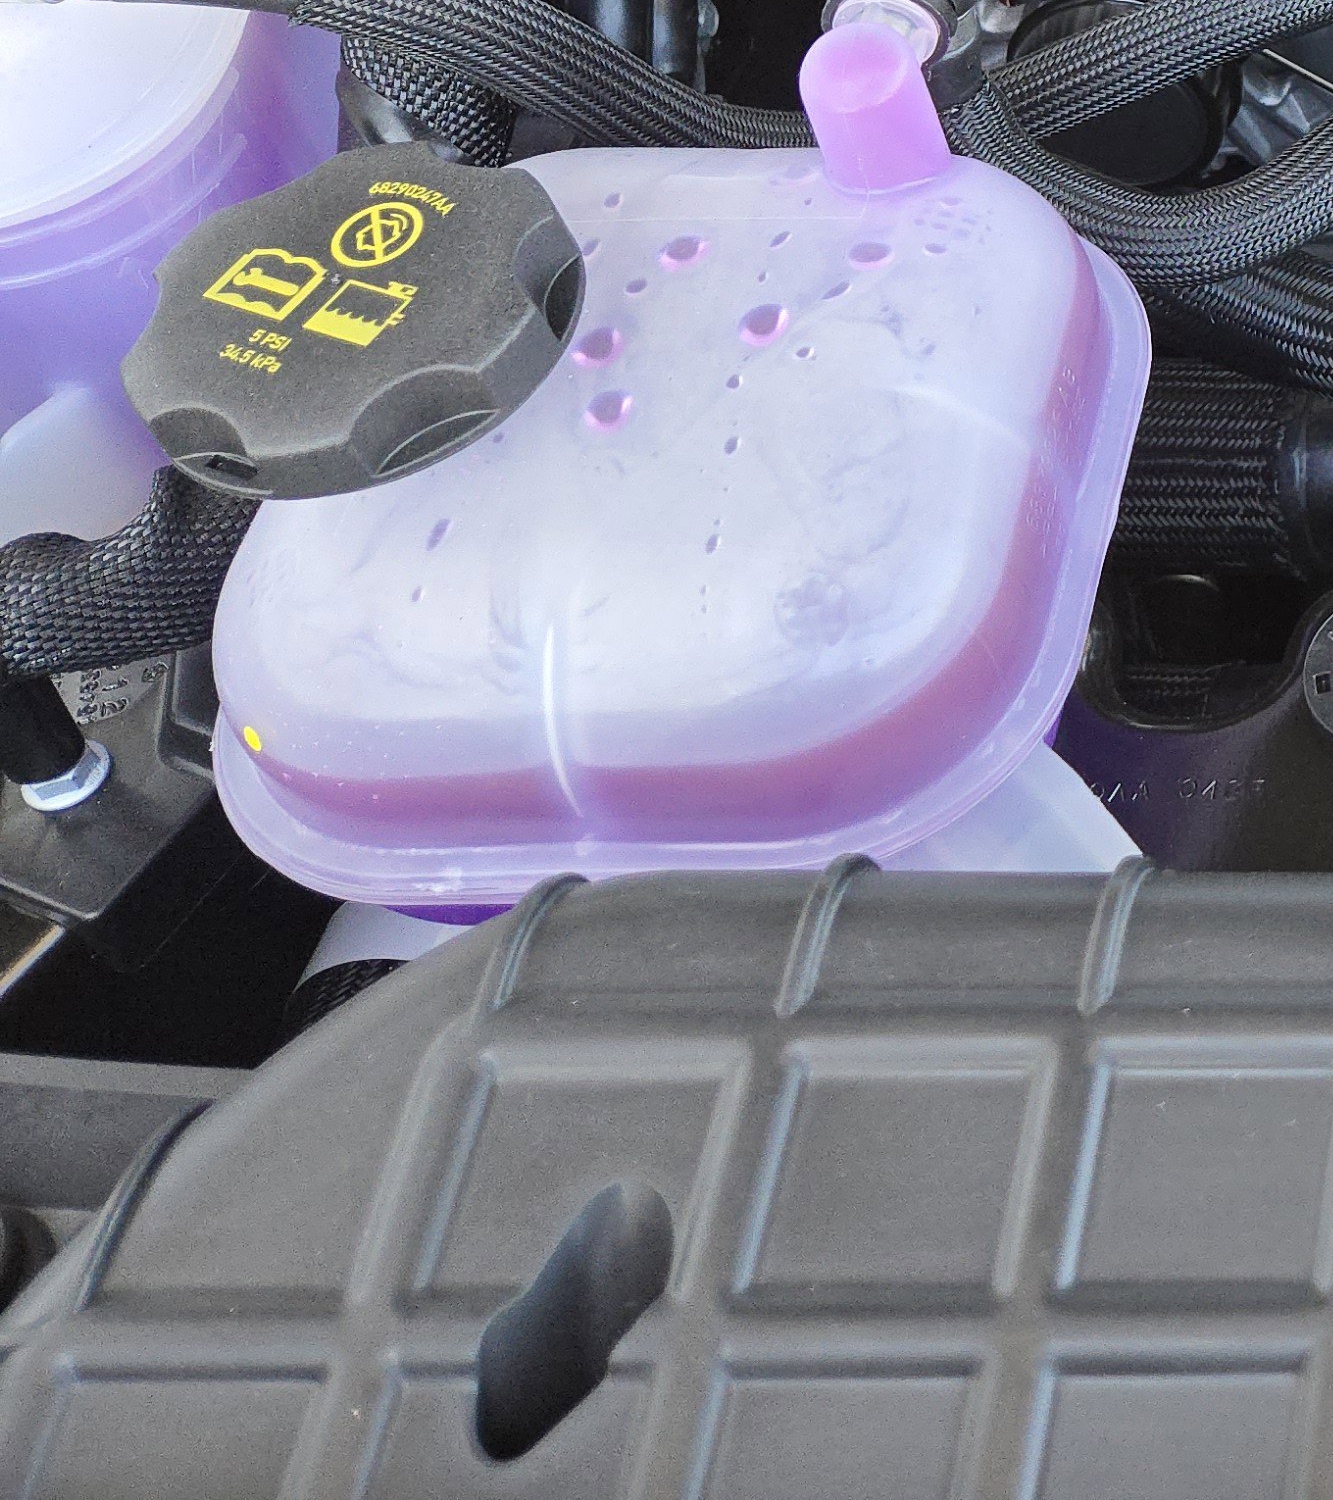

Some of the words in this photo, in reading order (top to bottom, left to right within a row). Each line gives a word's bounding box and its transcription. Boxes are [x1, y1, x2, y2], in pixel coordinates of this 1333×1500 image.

[368, 180, 457, 218] 68290247AA
[248, 328, 264, 343] 5
[262, 332, 293, 352] PSI
[219, 342, 254, 364] 34.5
[252, 351, 283, 374] kPa
